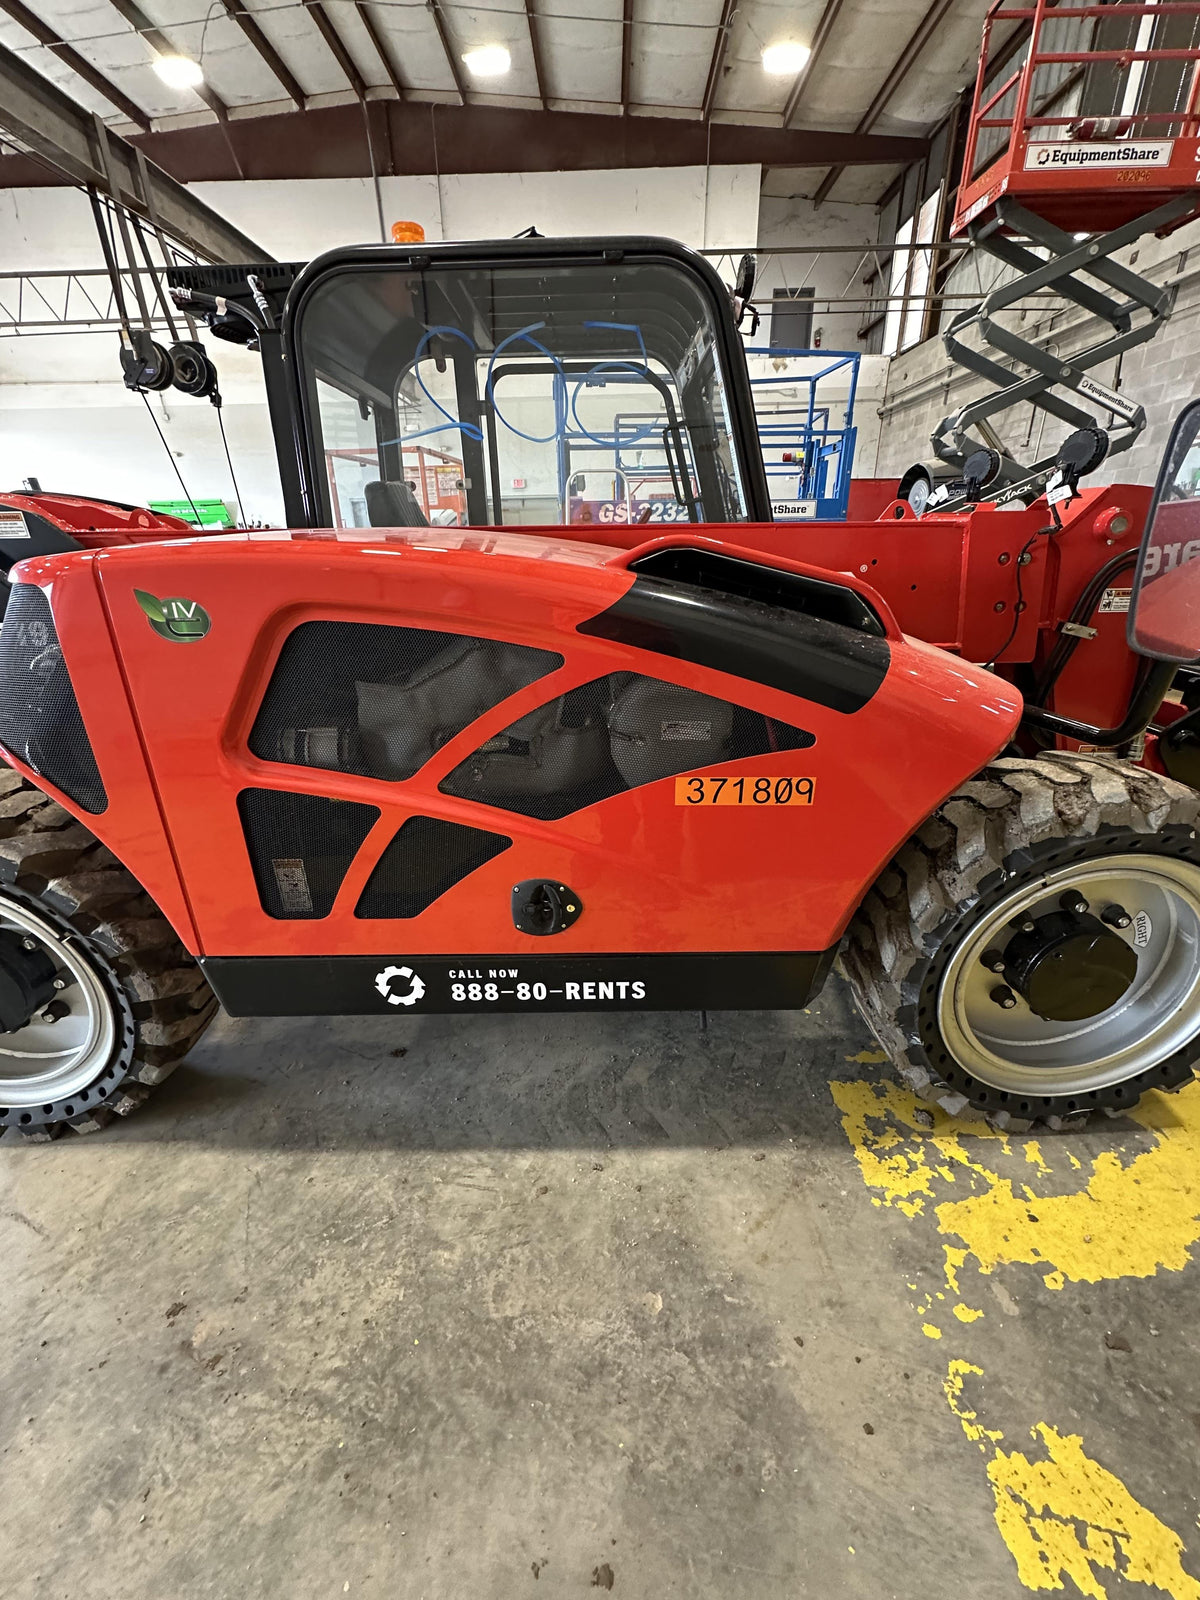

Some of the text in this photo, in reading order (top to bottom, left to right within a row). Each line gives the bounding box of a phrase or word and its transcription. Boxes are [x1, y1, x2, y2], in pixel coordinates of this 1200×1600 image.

[1051, 147, 1160, 165] EquipmentShare
[1087, 383, 1134, 413] EquipmentShare
[770, 504, 808, 515] tShare
[171, 602, 197, 618] IV
[686, 777, 815, 804] 371809
[1136, 915, 1148, 944] RIGHT
[448, 969, 519, 979] CALL NOW
